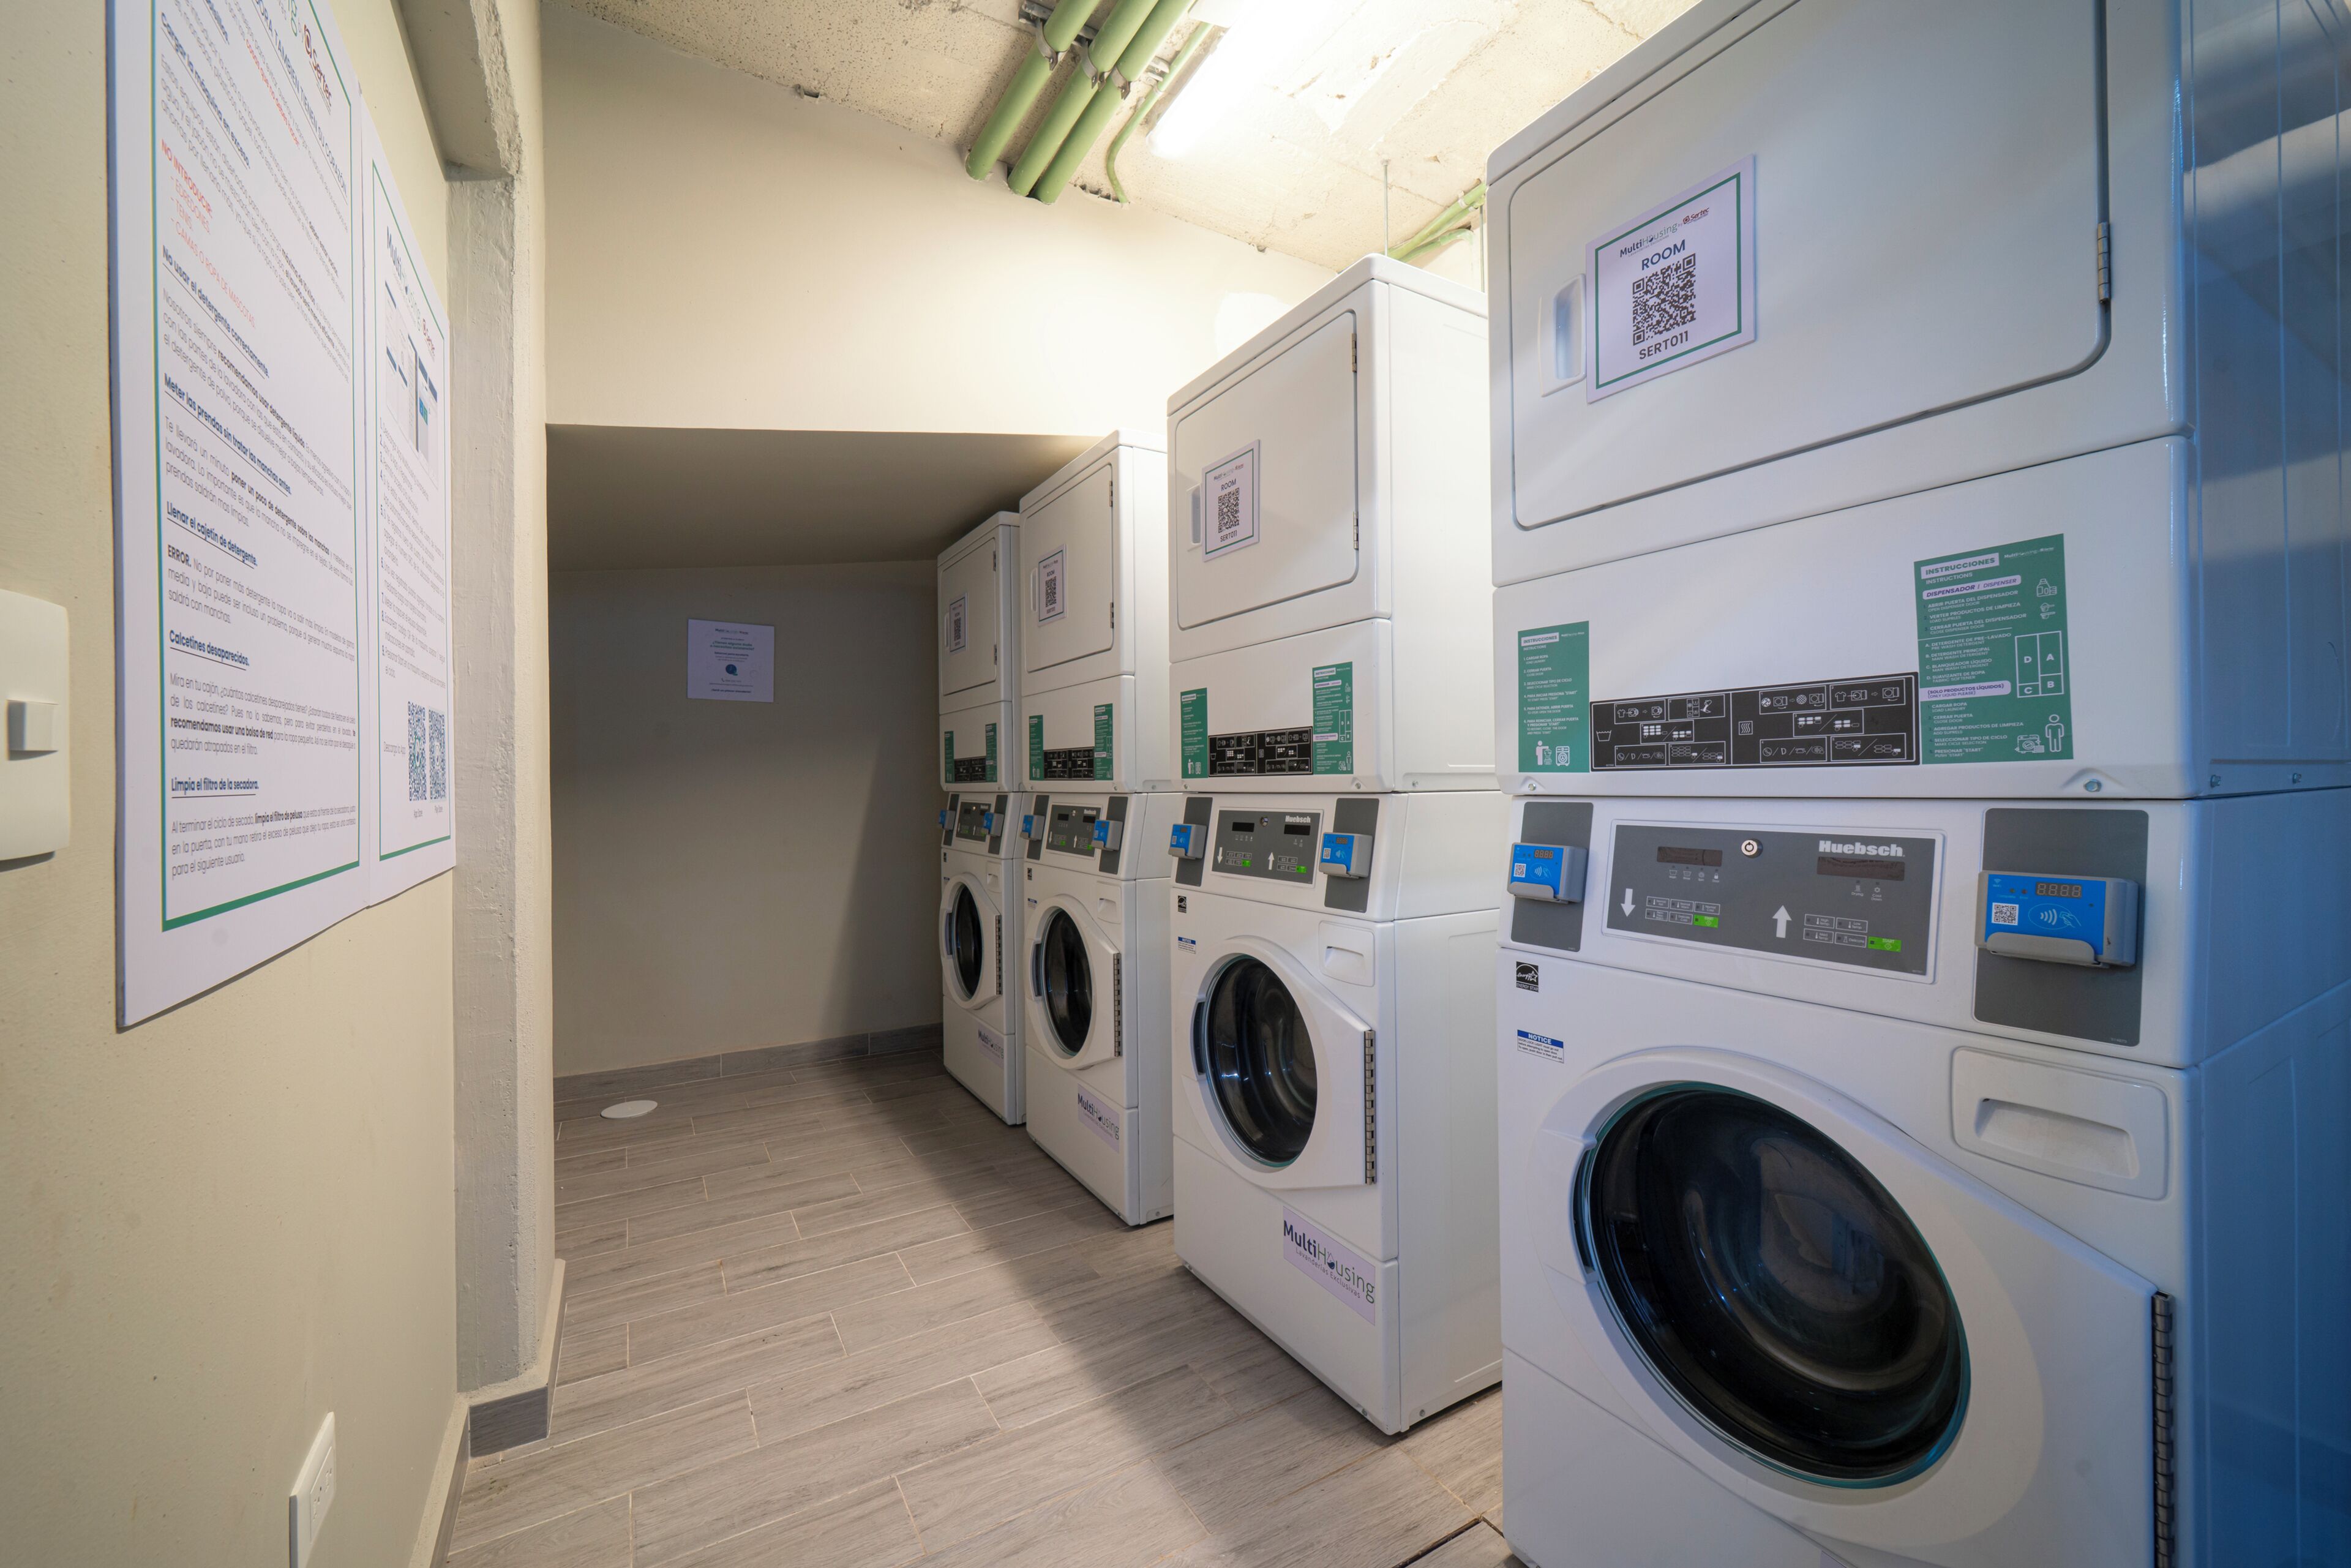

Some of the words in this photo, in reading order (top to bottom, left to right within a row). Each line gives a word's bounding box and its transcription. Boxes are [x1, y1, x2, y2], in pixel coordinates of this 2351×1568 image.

[161, 12, 186, 65] Cargar
[187, 56, 193, 78] la
[194, 71, 222, 123] máquina
[223, 119, 230, 137] en
[230, 131, 250, 170] exceso.
[311, 48, 332, 107] Sertec
[300, 85, 317, 133] TIENEN
[318, 124, 324, 150] SU
[161, 138, 171, 164] NO
[173, 154, 212, 220] INTRODUCIR:
[1620, 223, 1678, 258] MultiHousing
[1690, 207, 1710, 221] Sertec
[1641, 239, 1685, 271] ROOM
[176, 220, 198, 258] CAMAS
[199, 249, 204, 266] O
[204, 257, 220, 286] ROPA
[221, 277, 227, 295] DE
[230, 288, 255, 329] MASCOTAS.
[162, 244, 173, 268] No
[174, 261, 189, 288] usar
[190, 281, 197, 296] el
[197, 286, 230, 334] detergente
[231, 328, 269, 379] correctamente.
[1639, 331, 1689, 360] SERT011
[217, 350, 258, 400] recomendamos
[258, 393, 269, 411] usar
[269, 402, 291, 435] detergente
[164, 373, 185, 403] Meter
[186, 392, 196, 413] las
[197, 405, 222, 435] prendas
[233, 434, 248, 458] tratar
[257, 459, 278, 484] manchas
[279, 478, 291, 496] antes.
[1221, 479, 1237, 491] ROOM
[231, 471, 246, 491] poner
[247, 485, 254, 497] un
[255, 490, 267, 507] poco
[268, 498, 273, 512] de
[274, 503, 296, 530] detergente
[297, 524, 307, 539] sobre
[313, 537, 329, 555] manchas
[167, 501, 189, 527] Llenar
[190, 517, 195, 531] el
[197, 522, 219, 544] cajetín
[219, 533, 227, 549] de
[227, 538, 257, 567] detergente.
[1220, 530, 1237, 542] SERT011
[167, 544, 192, 568] ERROR.
[1925, 557, 1995, 575] INSTRUCCIONES
[1925, 572, 1973, 584] INSTRUCTIONS
[1926, 585, 1975, 597] DISPENSADOR
[1983, 578, 2016, 588] DISPENSER
[1977, 590, 2018, 600] DISPENSADOR
[1950, 607, 1984, 616] PRODUCTOS
[1985, 613, 2027, 623] DISPENSADOR
[169, 629, 206, 653] Calcetines
[206, 642, 249, 667] desaparecidos.
[1523, 635, 1557, 644] INSTRUCCIONES
[1974, 632, 2011, 641] PRE-LAVADO
[170, 718, 221, 733] recomendamos
[222, 725, 234, 735] usar
[234, 727, 244, 736] una
[246, 726, 258, 738] bolsa
[259, 727, 265, 738] de
[171, 779, 195, 795] Limpia
[196, 779, 202, 791] el
[203, 779, 218, 791] filtro
[219, 779, 227, 790] de
[227, 779, 233, 790] la
[233, 779, 259, 790] secadora.
[255, 813, 269, 827] limpia
[269, 812, 274, 823] el
[274, 811, 284, 822] filtro
[284, 811, 289, 821] de
[290, 810, 302, 823] pelusa
[1818, 839, 1903, 857] Huebsch
[171, 865, 189, 882] para
[190, 860, 196, 874] el
[197, 855, 223, 875] siguiente
[225, 852, 245, 866] usuario.
[1528, 1033, 1551, 1045] NOTICE
[1078, 1093, 1119, 1140] MultiHousing
[1283, 1220, 1375, 1304] MultiHousing
